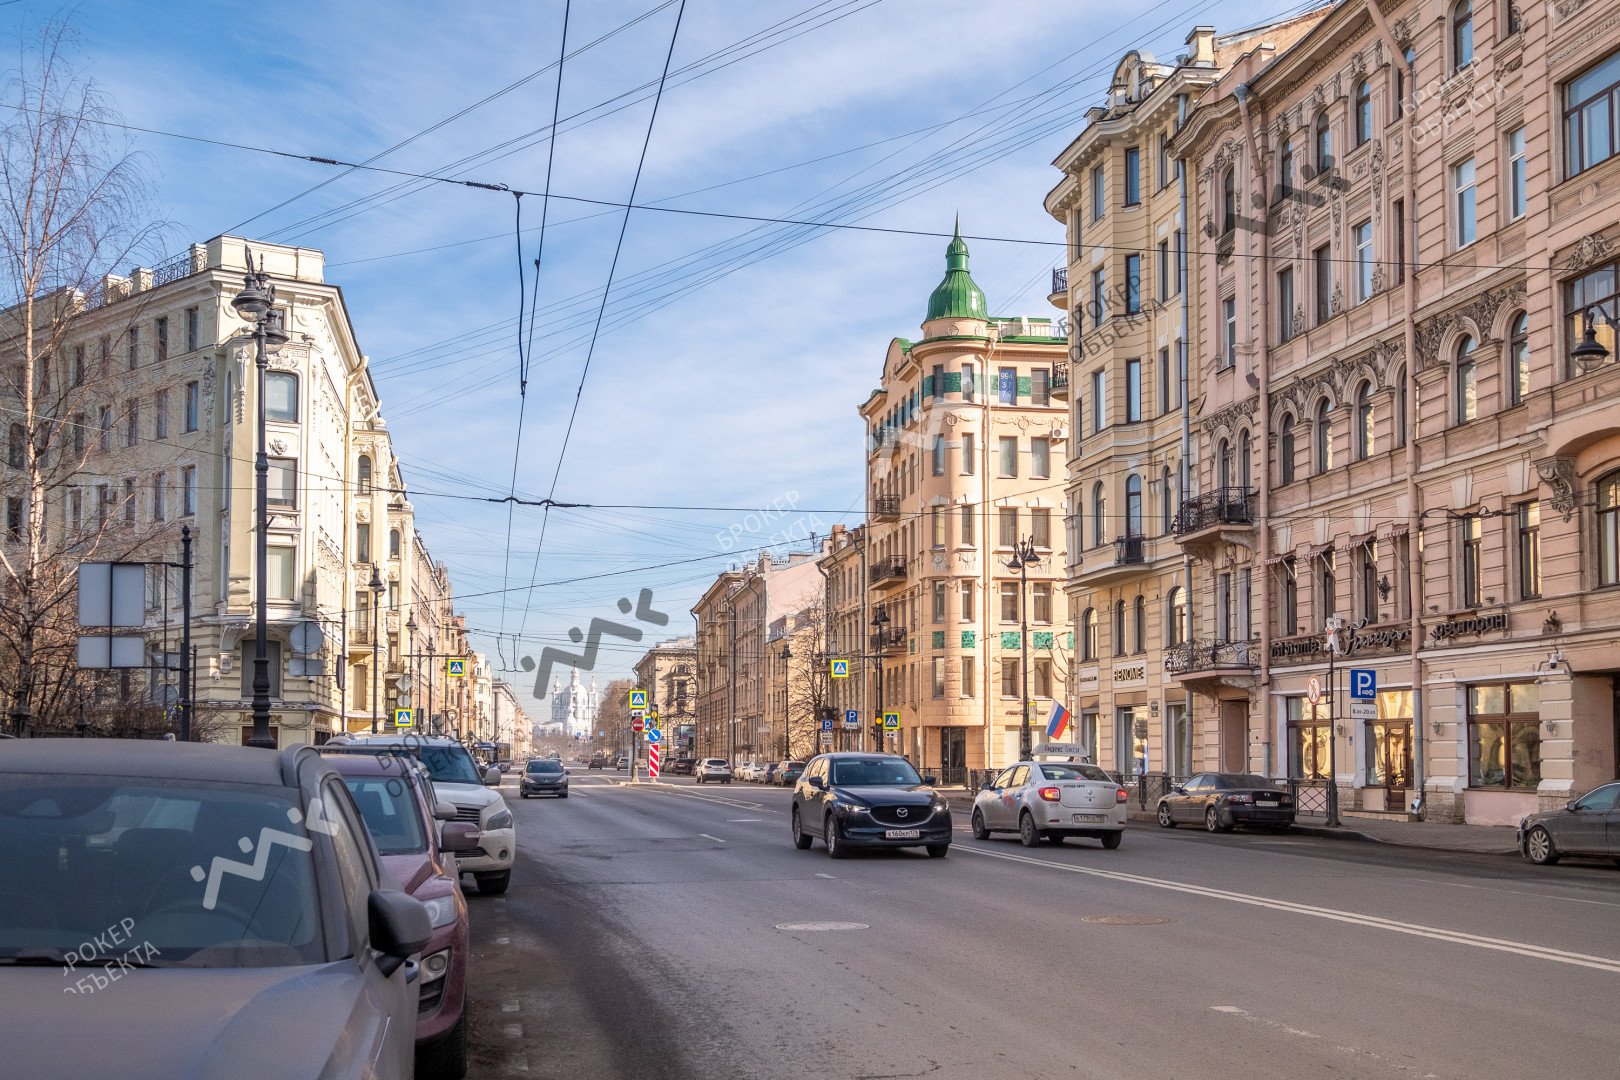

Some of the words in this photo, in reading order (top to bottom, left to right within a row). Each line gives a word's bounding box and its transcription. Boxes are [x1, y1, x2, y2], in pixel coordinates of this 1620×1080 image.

[1431, 613, 1508, 641] ресторан
[1114, 666, 1145, 681] RENOME
[1357, 672, 1372, 696] P
[1043, 743, 1064, 753] Яндекс
[1064, 744, 1080, 753] Такси
